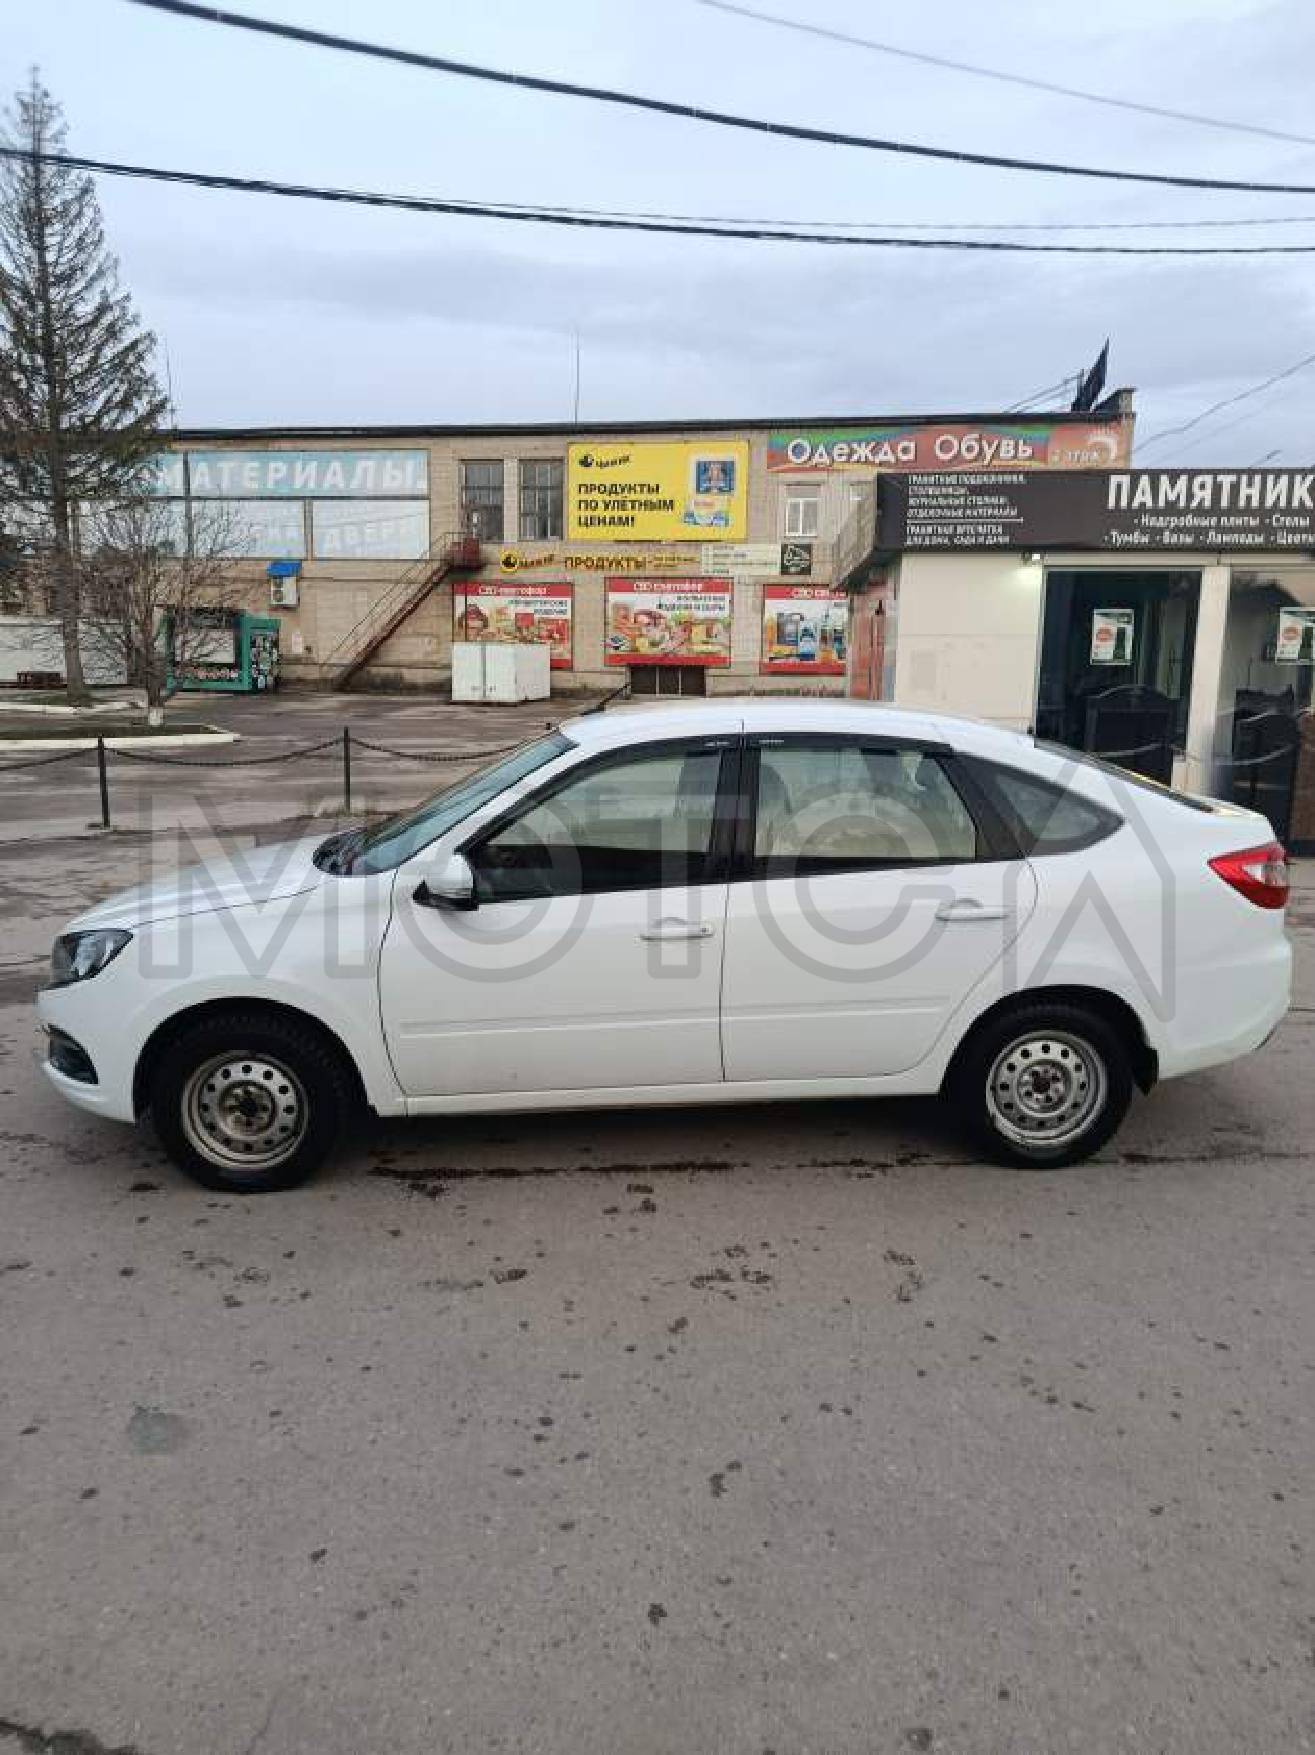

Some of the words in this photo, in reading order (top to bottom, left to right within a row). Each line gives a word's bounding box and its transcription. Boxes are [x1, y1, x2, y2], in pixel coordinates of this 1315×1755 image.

[786, 437, 917, 468] Одежда
[933, 433, 1034, 465] Обувь
[577, 482, 660, 497] ПРОДУКТЫ
[1107, 473, 1314, 510] ПАМЯТНИК
[577, 499, 599, 512] ПО
[602, 496, 675, 512] УЛЁТНЫМ
[577, 515, 636, 529] ЦЕНАМ!
[1141, 512, 1217, 529] Надгробные
[1110, 529, 1150, 548] Тумбы
[564, 555, 648, 571] ПРОДУКТЫ
